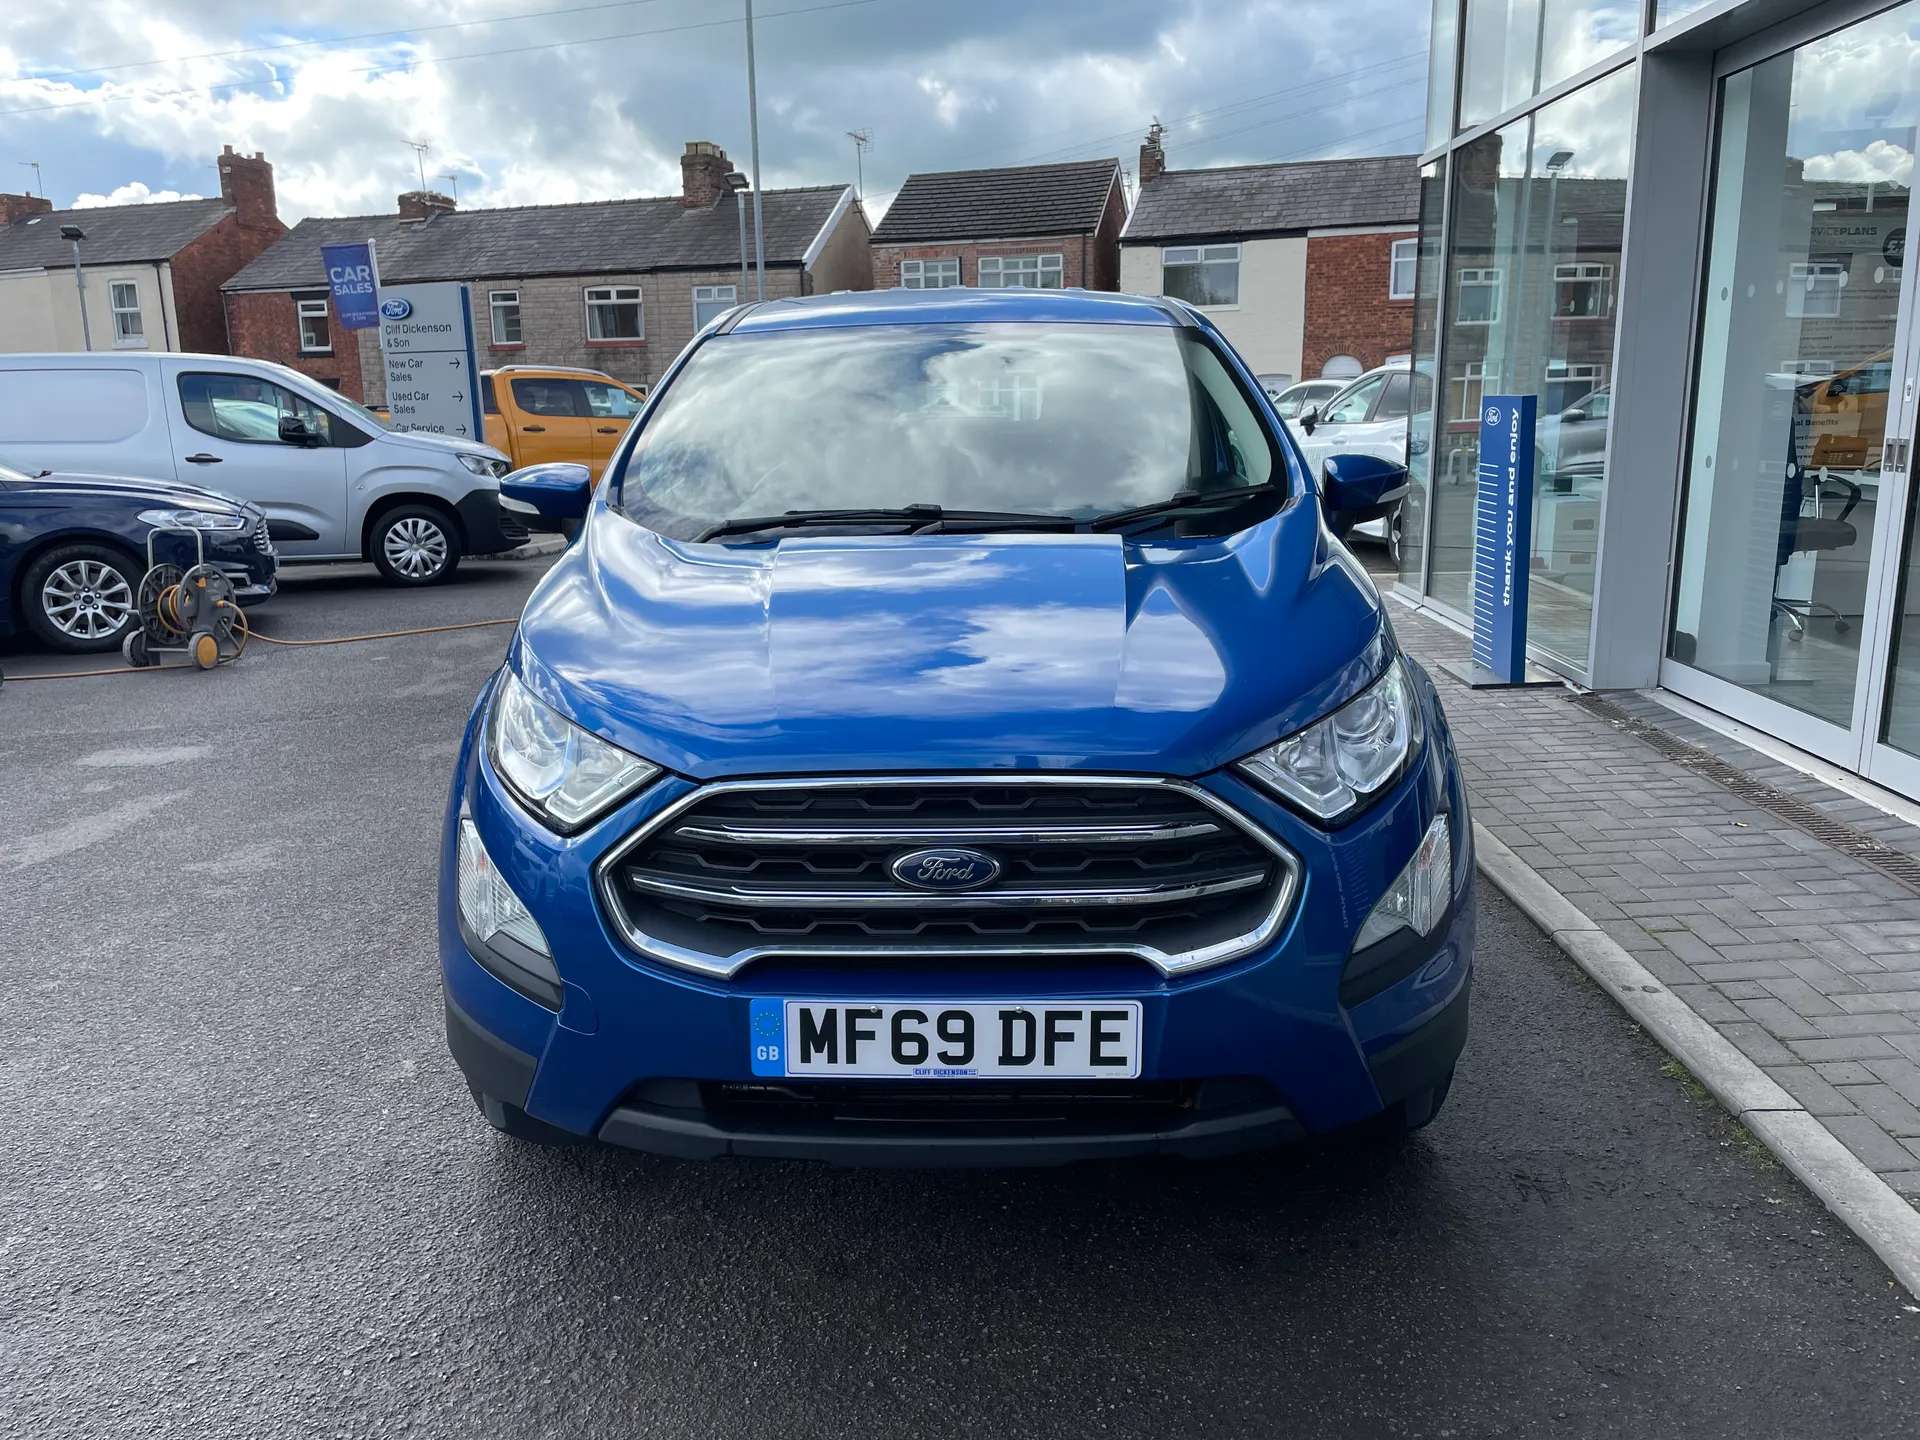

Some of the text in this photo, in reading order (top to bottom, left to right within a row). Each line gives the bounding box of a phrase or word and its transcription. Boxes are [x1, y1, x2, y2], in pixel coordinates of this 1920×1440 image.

[330, 264, 371, 283] CAR
[334, 282, 373, 296] SALES
[385, 323, 452, 335] Cliff Dickenson
[387, 338, 410, 348] & Son
[389, 358, 423, 369] New Car
[390, 371, 412, 382] Sales
[392, 390, 430, 401] Used Car
[393, 403, 416, 414] Sales
[395, 423, 445, 433] Car Service
[1503, 407, 1519, 607] thank you and enjoy
[917, 856, 976, 881] Ford
[799, 1008, 1129, 1067] MF69 DFE
[756, 1045, 780, 1061] GB
[914, 1068, 931, 1076] CLIFF
[933, 1068, 968, 1076] DICKENSON
